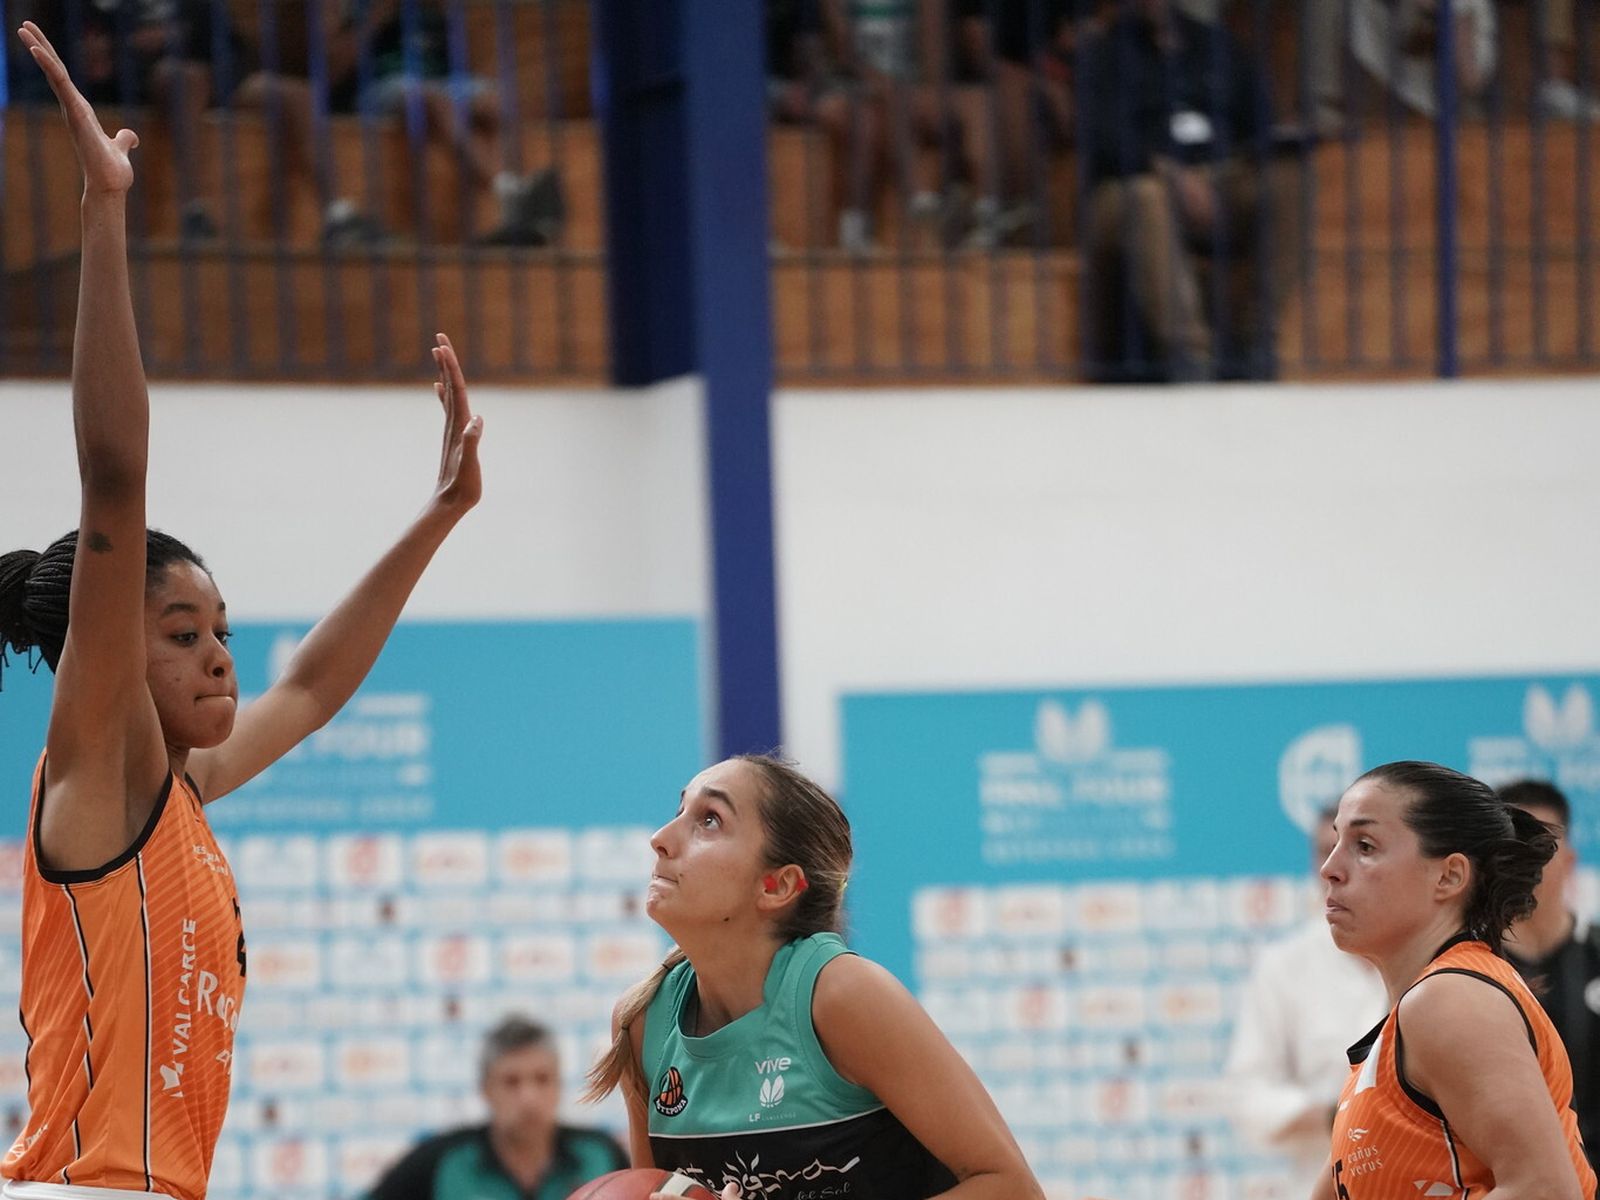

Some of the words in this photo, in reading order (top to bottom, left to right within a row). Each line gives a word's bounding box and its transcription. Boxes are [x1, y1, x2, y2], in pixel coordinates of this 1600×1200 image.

[755, 1056, 792, 1074] vive
[749, 1112, 761, 1122] LF
[1347, 1144, 1379, 1164] cañus
[1350, 1158, 1384, 1178] verus
[820, 1181, 851, 1199] Sol
